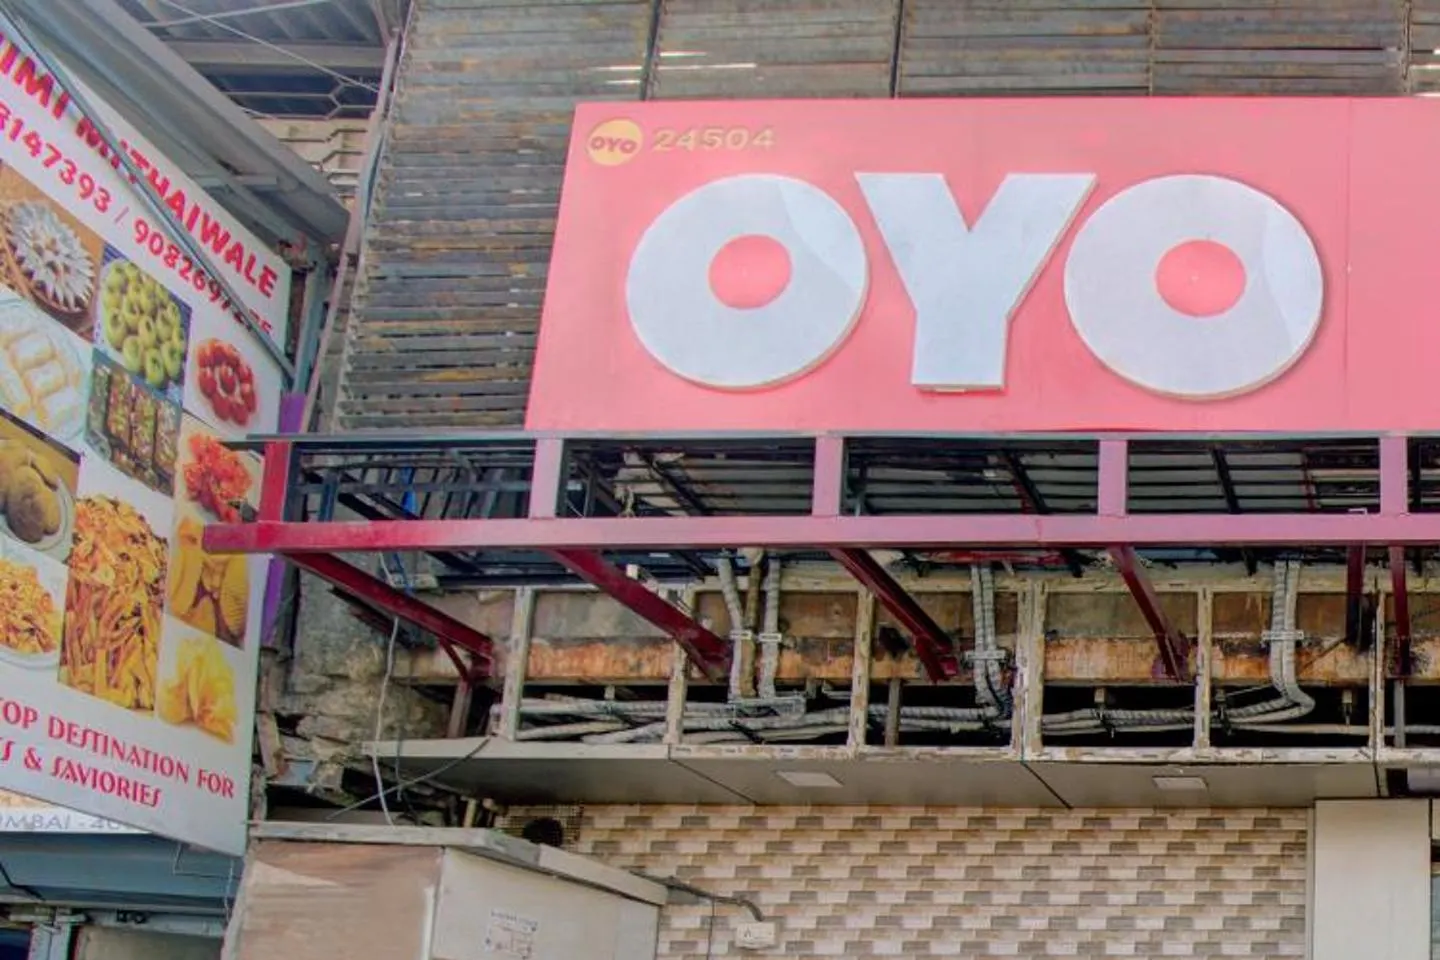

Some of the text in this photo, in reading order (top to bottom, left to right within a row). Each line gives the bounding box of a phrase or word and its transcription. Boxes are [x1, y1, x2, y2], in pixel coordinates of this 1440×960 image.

[0, 32, 70, 119] IMI
[590, 126, 775, 154] OYO 24504
[625, 172, 1325, 400] OYO
[0, 697, 235, 799] OP DESTINATION FOR
[0, 813, 70, 830] MBAI
